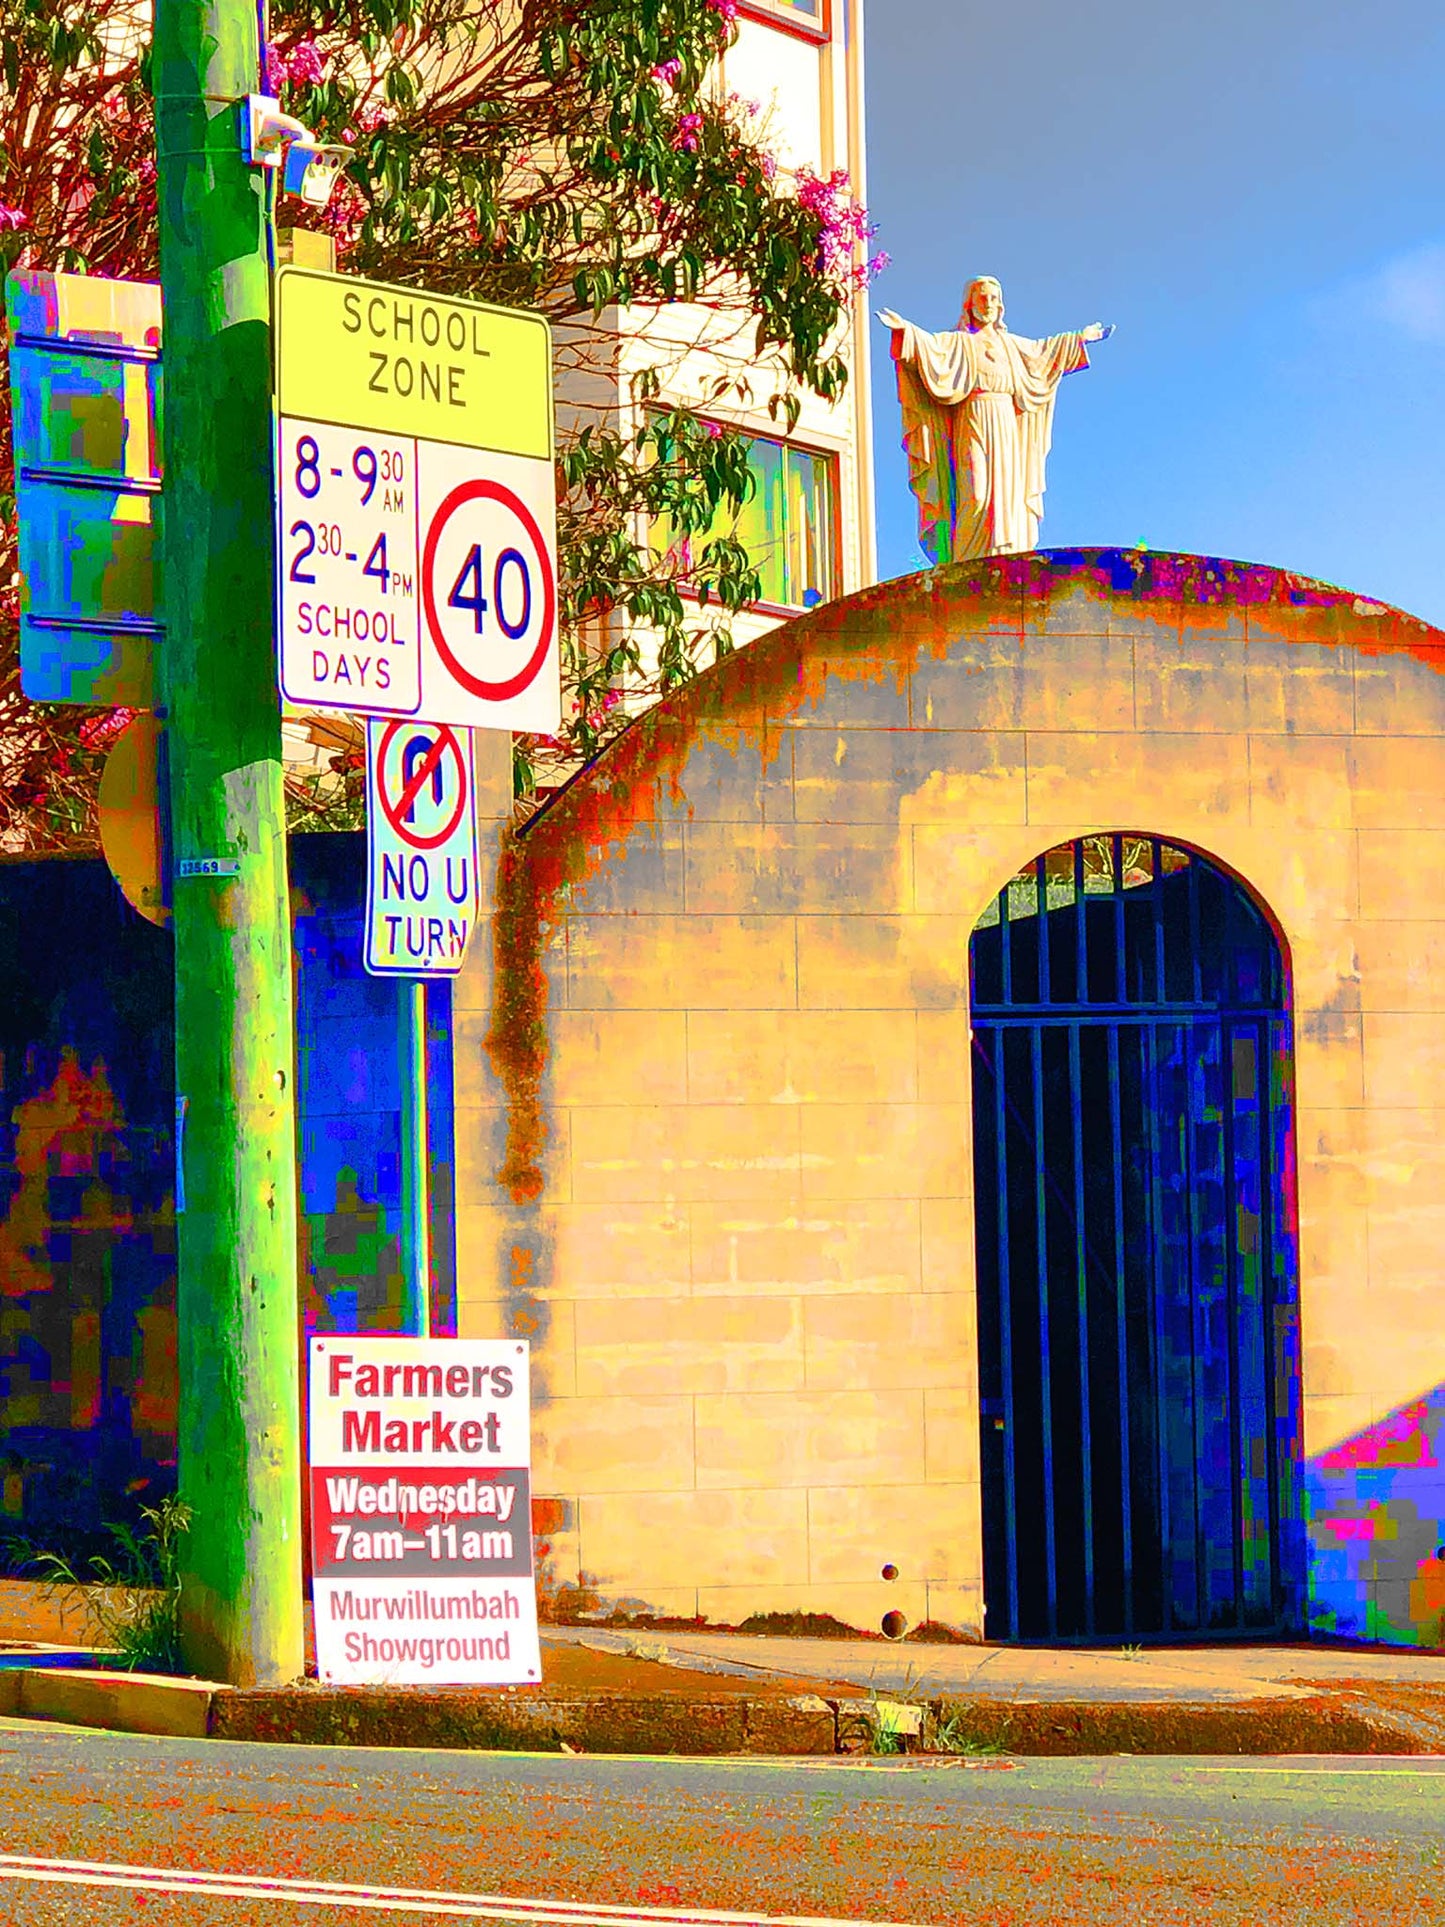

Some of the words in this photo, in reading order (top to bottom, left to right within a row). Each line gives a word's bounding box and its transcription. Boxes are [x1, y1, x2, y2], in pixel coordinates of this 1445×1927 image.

[342, 292, 490, 357] SCHOOL
[368, 351, 466, 407] ZONE
[447, 543, 531, 640] 40
[297, 602, 405, 645] SCHOOL
[313, 650, 391, 689] DAYS
[382, 853, 429, 901] NO
[446, 857, 468, 904] U
[384, 916, 467, 957] TURN
[329, 1355, 513, 1398] Farmers
[342, 1411, 501, 1453] Market
[325, 1478, 515, 1521] Wednesday
[330, 1590, 520, 1621] Murwillumbah
[345, 1631, 511, 1667] Showground
